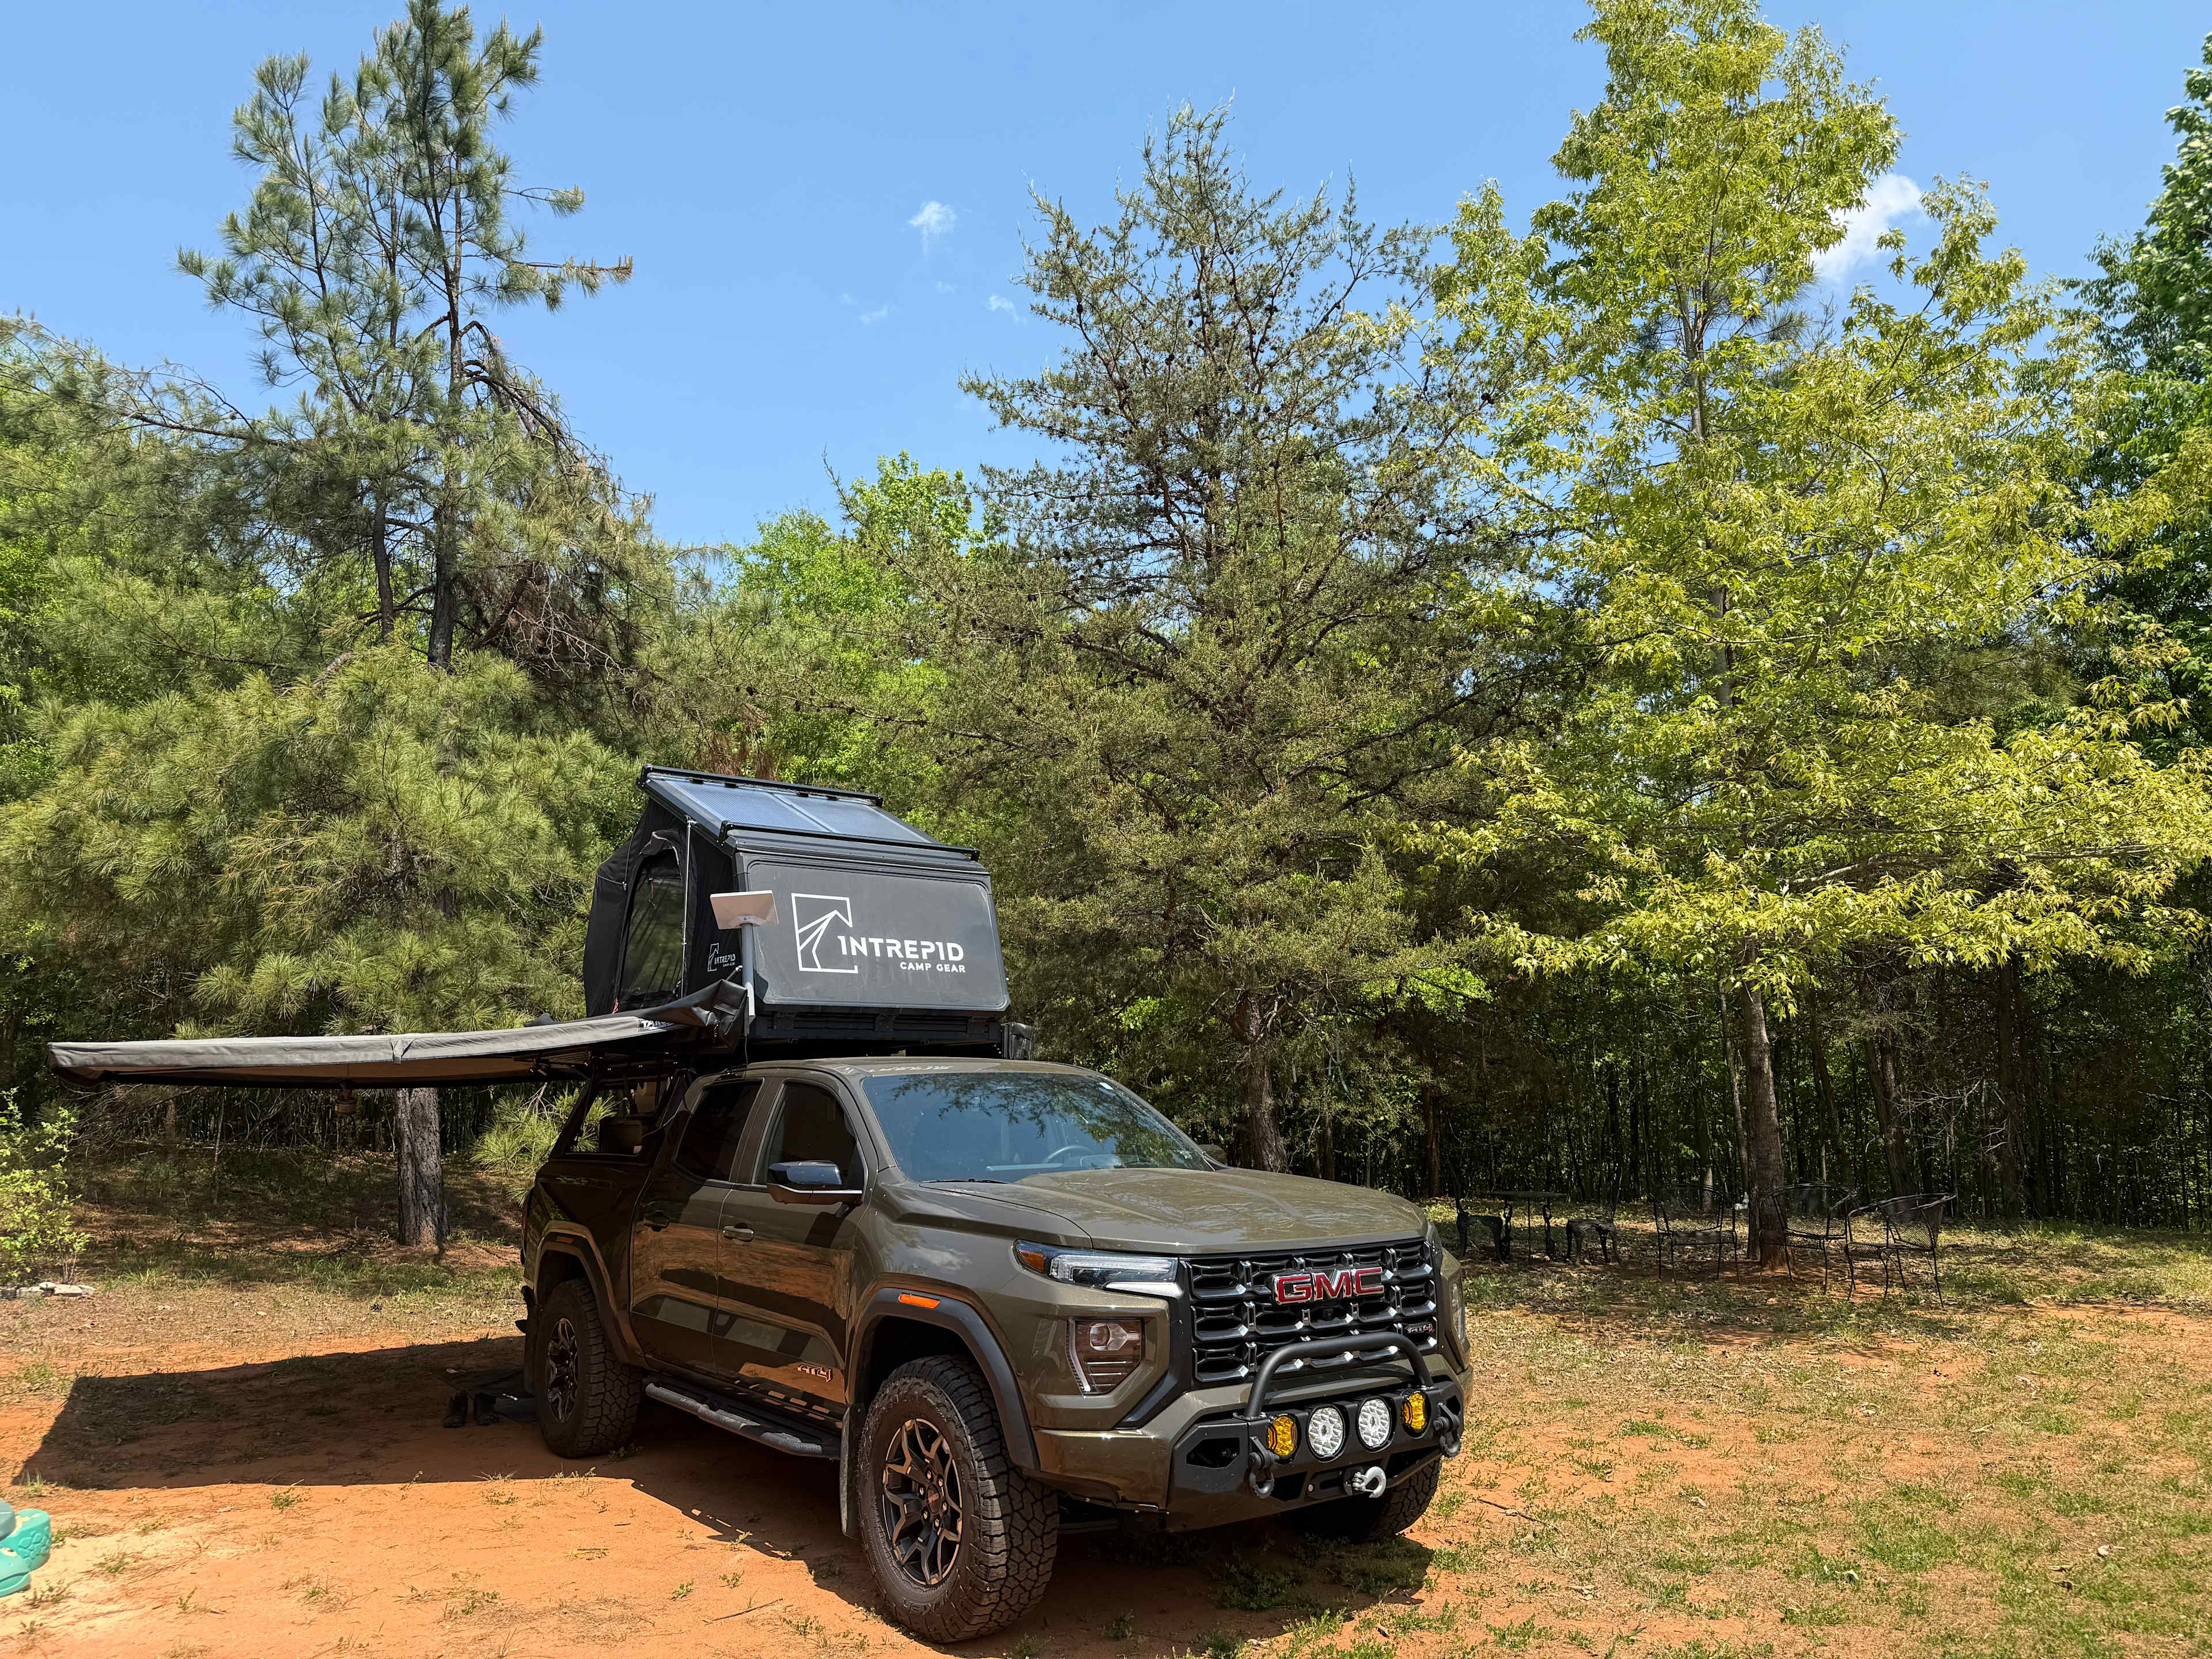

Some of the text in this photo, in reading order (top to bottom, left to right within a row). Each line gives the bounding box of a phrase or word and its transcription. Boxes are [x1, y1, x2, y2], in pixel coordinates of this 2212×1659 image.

[837, 935, 964, 961] INTREPID
[900, 961, 966, 973] CAMP GEAR
[1272, 1266, 1384, 1305] GMC
[797, 1363, 832, 1382] AT4
